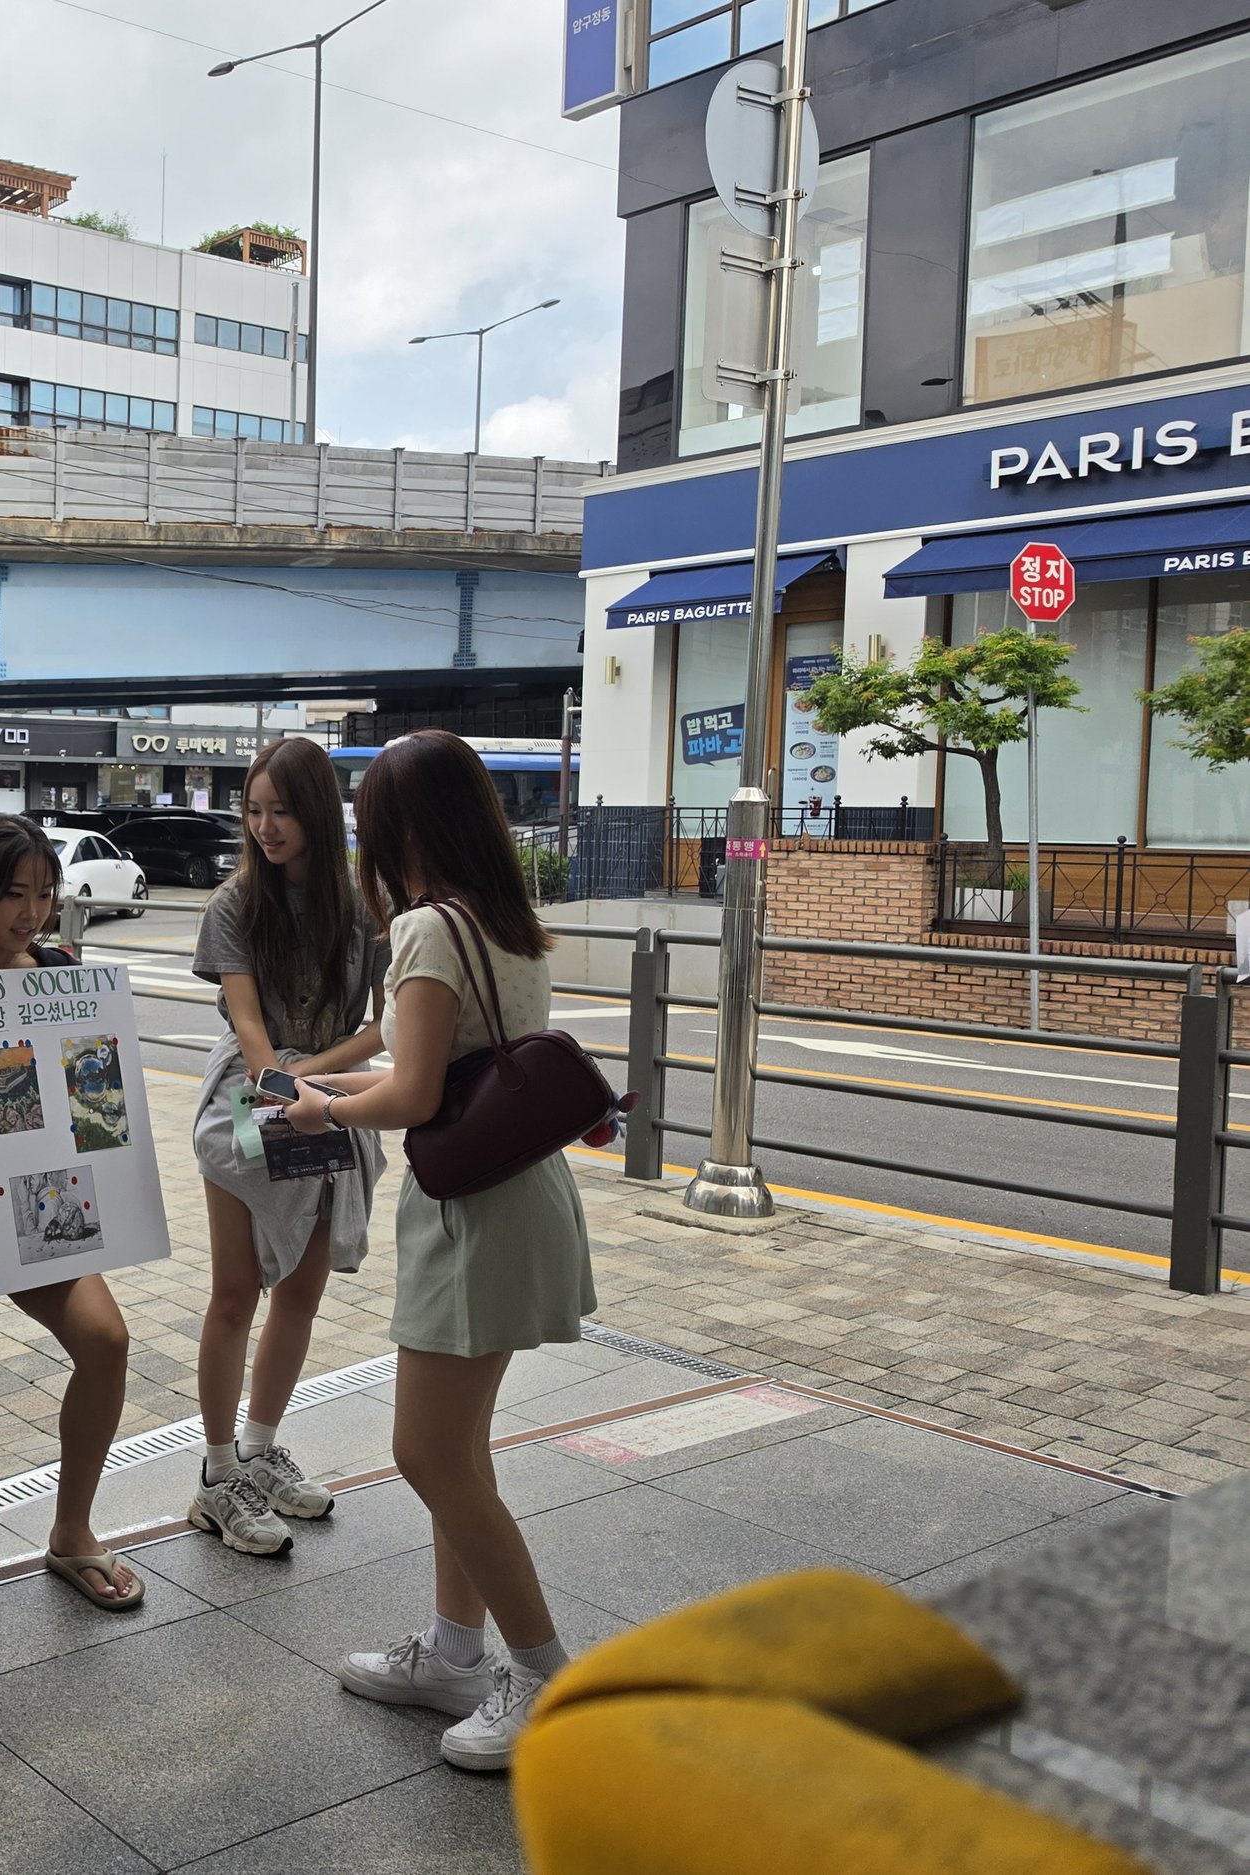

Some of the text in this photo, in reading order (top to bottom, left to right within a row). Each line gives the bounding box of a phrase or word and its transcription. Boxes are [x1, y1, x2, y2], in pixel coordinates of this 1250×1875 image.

[572, 6, 611, 34] 압구정동
[990, 420, 1199, 490] PARIS
[1019, 556, 1065, 586] 정지
[1163, 552, 1235, 572] PARIS
[1019, 586, 1065, 609] STOP
[627, 601, 753, 625] PARIS BAGUETTE
[686, 712, 734, 736] 밥 먹고
[687, 733, 722, 757] 파바
[22, 966, 118, 997] SOCIETY
[18, 999, 98, 1025] 깊으셨나요?
